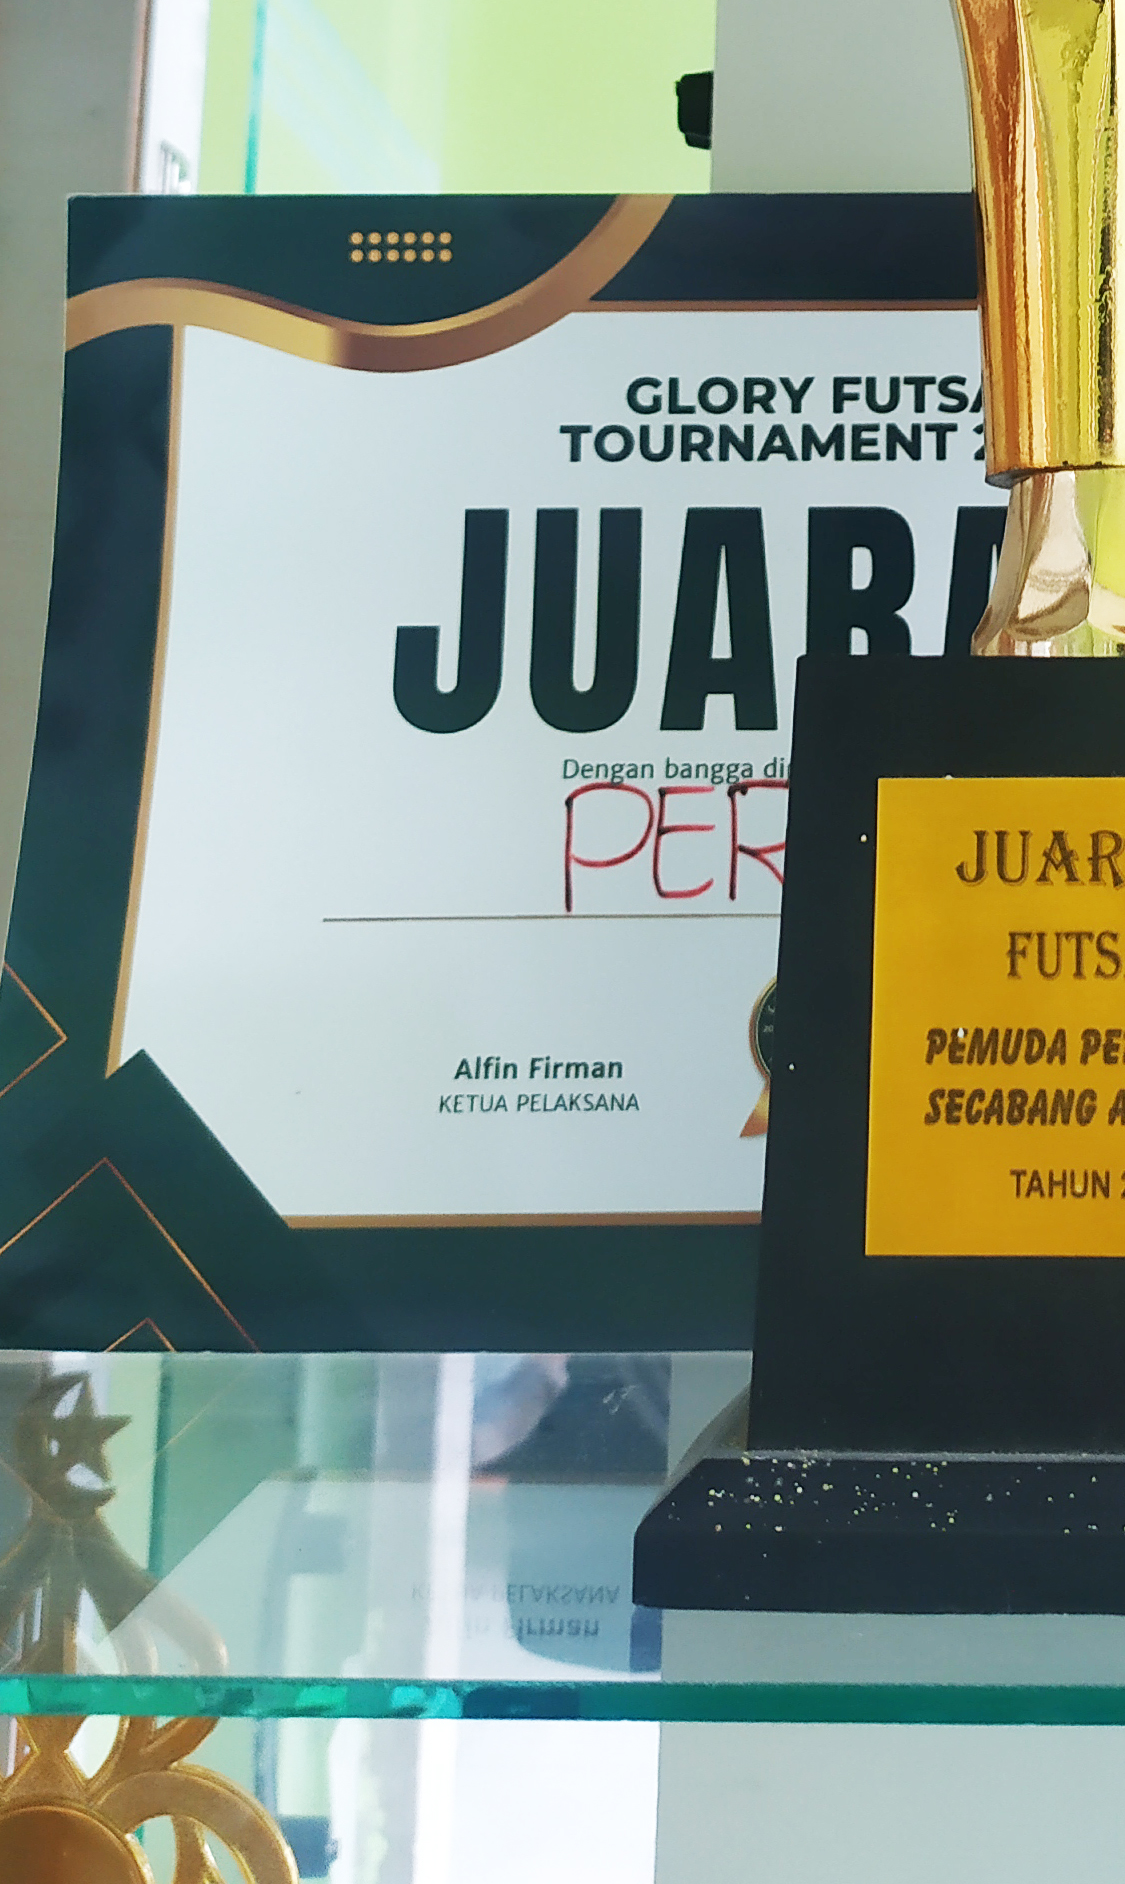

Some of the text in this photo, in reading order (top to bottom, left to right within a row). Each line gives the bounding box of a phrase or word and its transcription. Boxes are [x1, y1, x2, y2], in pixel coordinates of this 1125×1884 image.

[626, 376, 815, 415] GLORY
[559, 423, 958, 462] TOURNAMENT
[562, 759, 654, 786] Dengan
[665, 757, 753, 785] bangga
[925, 1027, 1067, 1065] PEMUDA
[454, 1055, 623, 1080] Alfin Firman
[439, 1092, 640, 1114] KETUA PELAKSANA
[924, 1087, 1098, 1126] SECABANG
[1009, 1169, 1111, 1199] TAHUN
